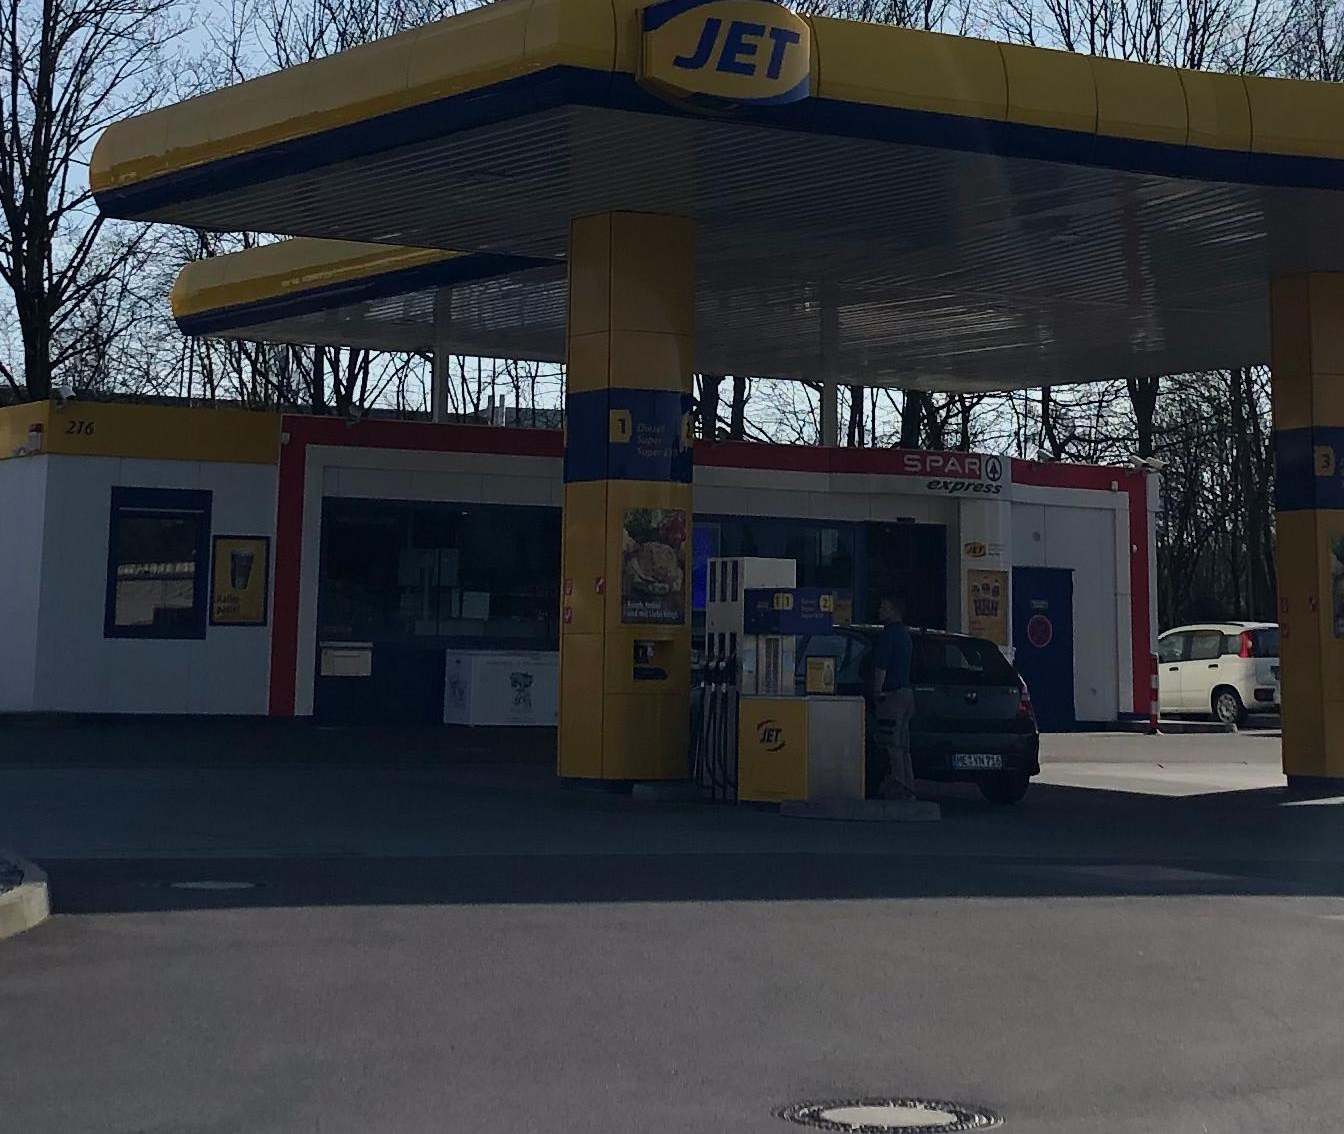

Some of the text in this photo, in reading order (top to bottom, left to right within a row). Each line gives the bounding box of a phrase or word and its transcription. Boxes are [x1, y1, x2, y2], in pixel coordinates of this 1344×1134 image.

[673, 18, 800, 80] JET
[64, 420, 95, 435] 216
[903, 454, 980, 475] SPAR
[927, 479, 1003, 494] express
[760, 728, 783, 743] JET
